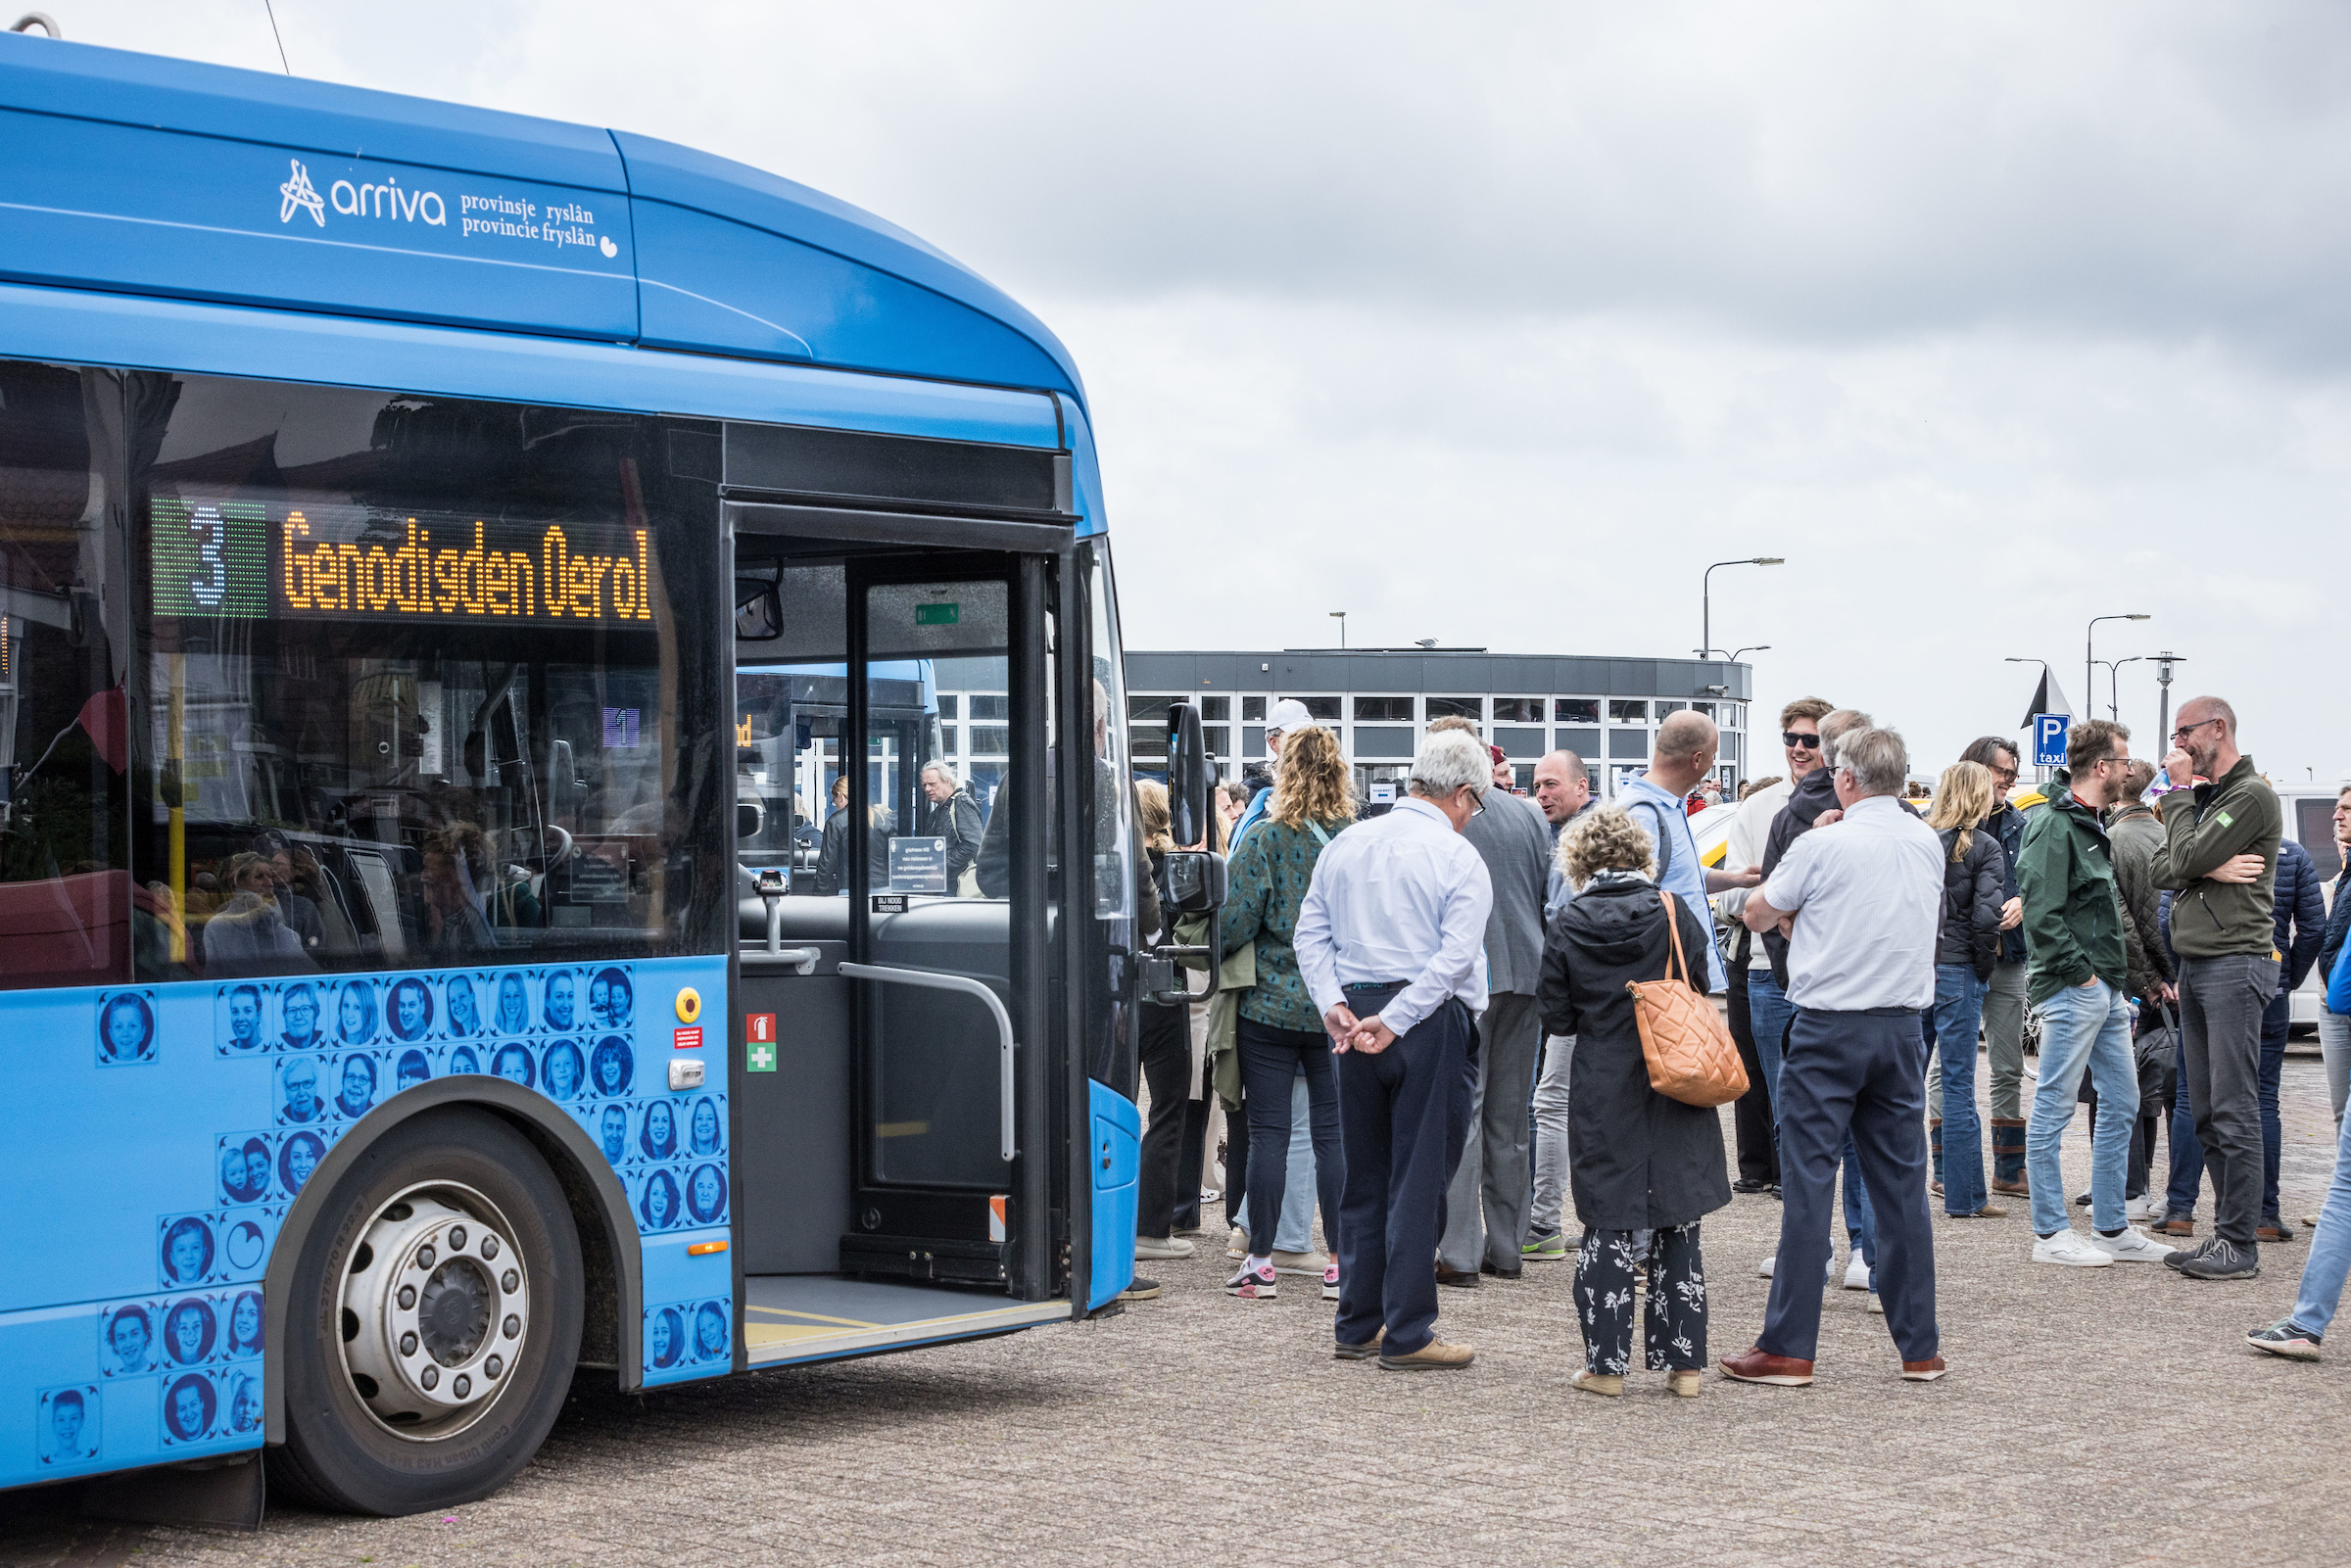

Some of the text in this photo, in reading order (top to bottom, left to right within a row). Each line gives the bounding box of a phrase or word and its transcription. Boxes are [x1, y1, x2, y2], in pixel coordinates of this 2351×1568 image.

[330, 176, 447, 227] arriva
[460, 195, 536, 221] provinsje
[462, 217, 597, 249] provincie fryslân
[190, 505, 650, 619] 3 Genodigden Oerol
[2042, 718, 2063, 744] P
[2039, 752, 2065, 764] taxi
